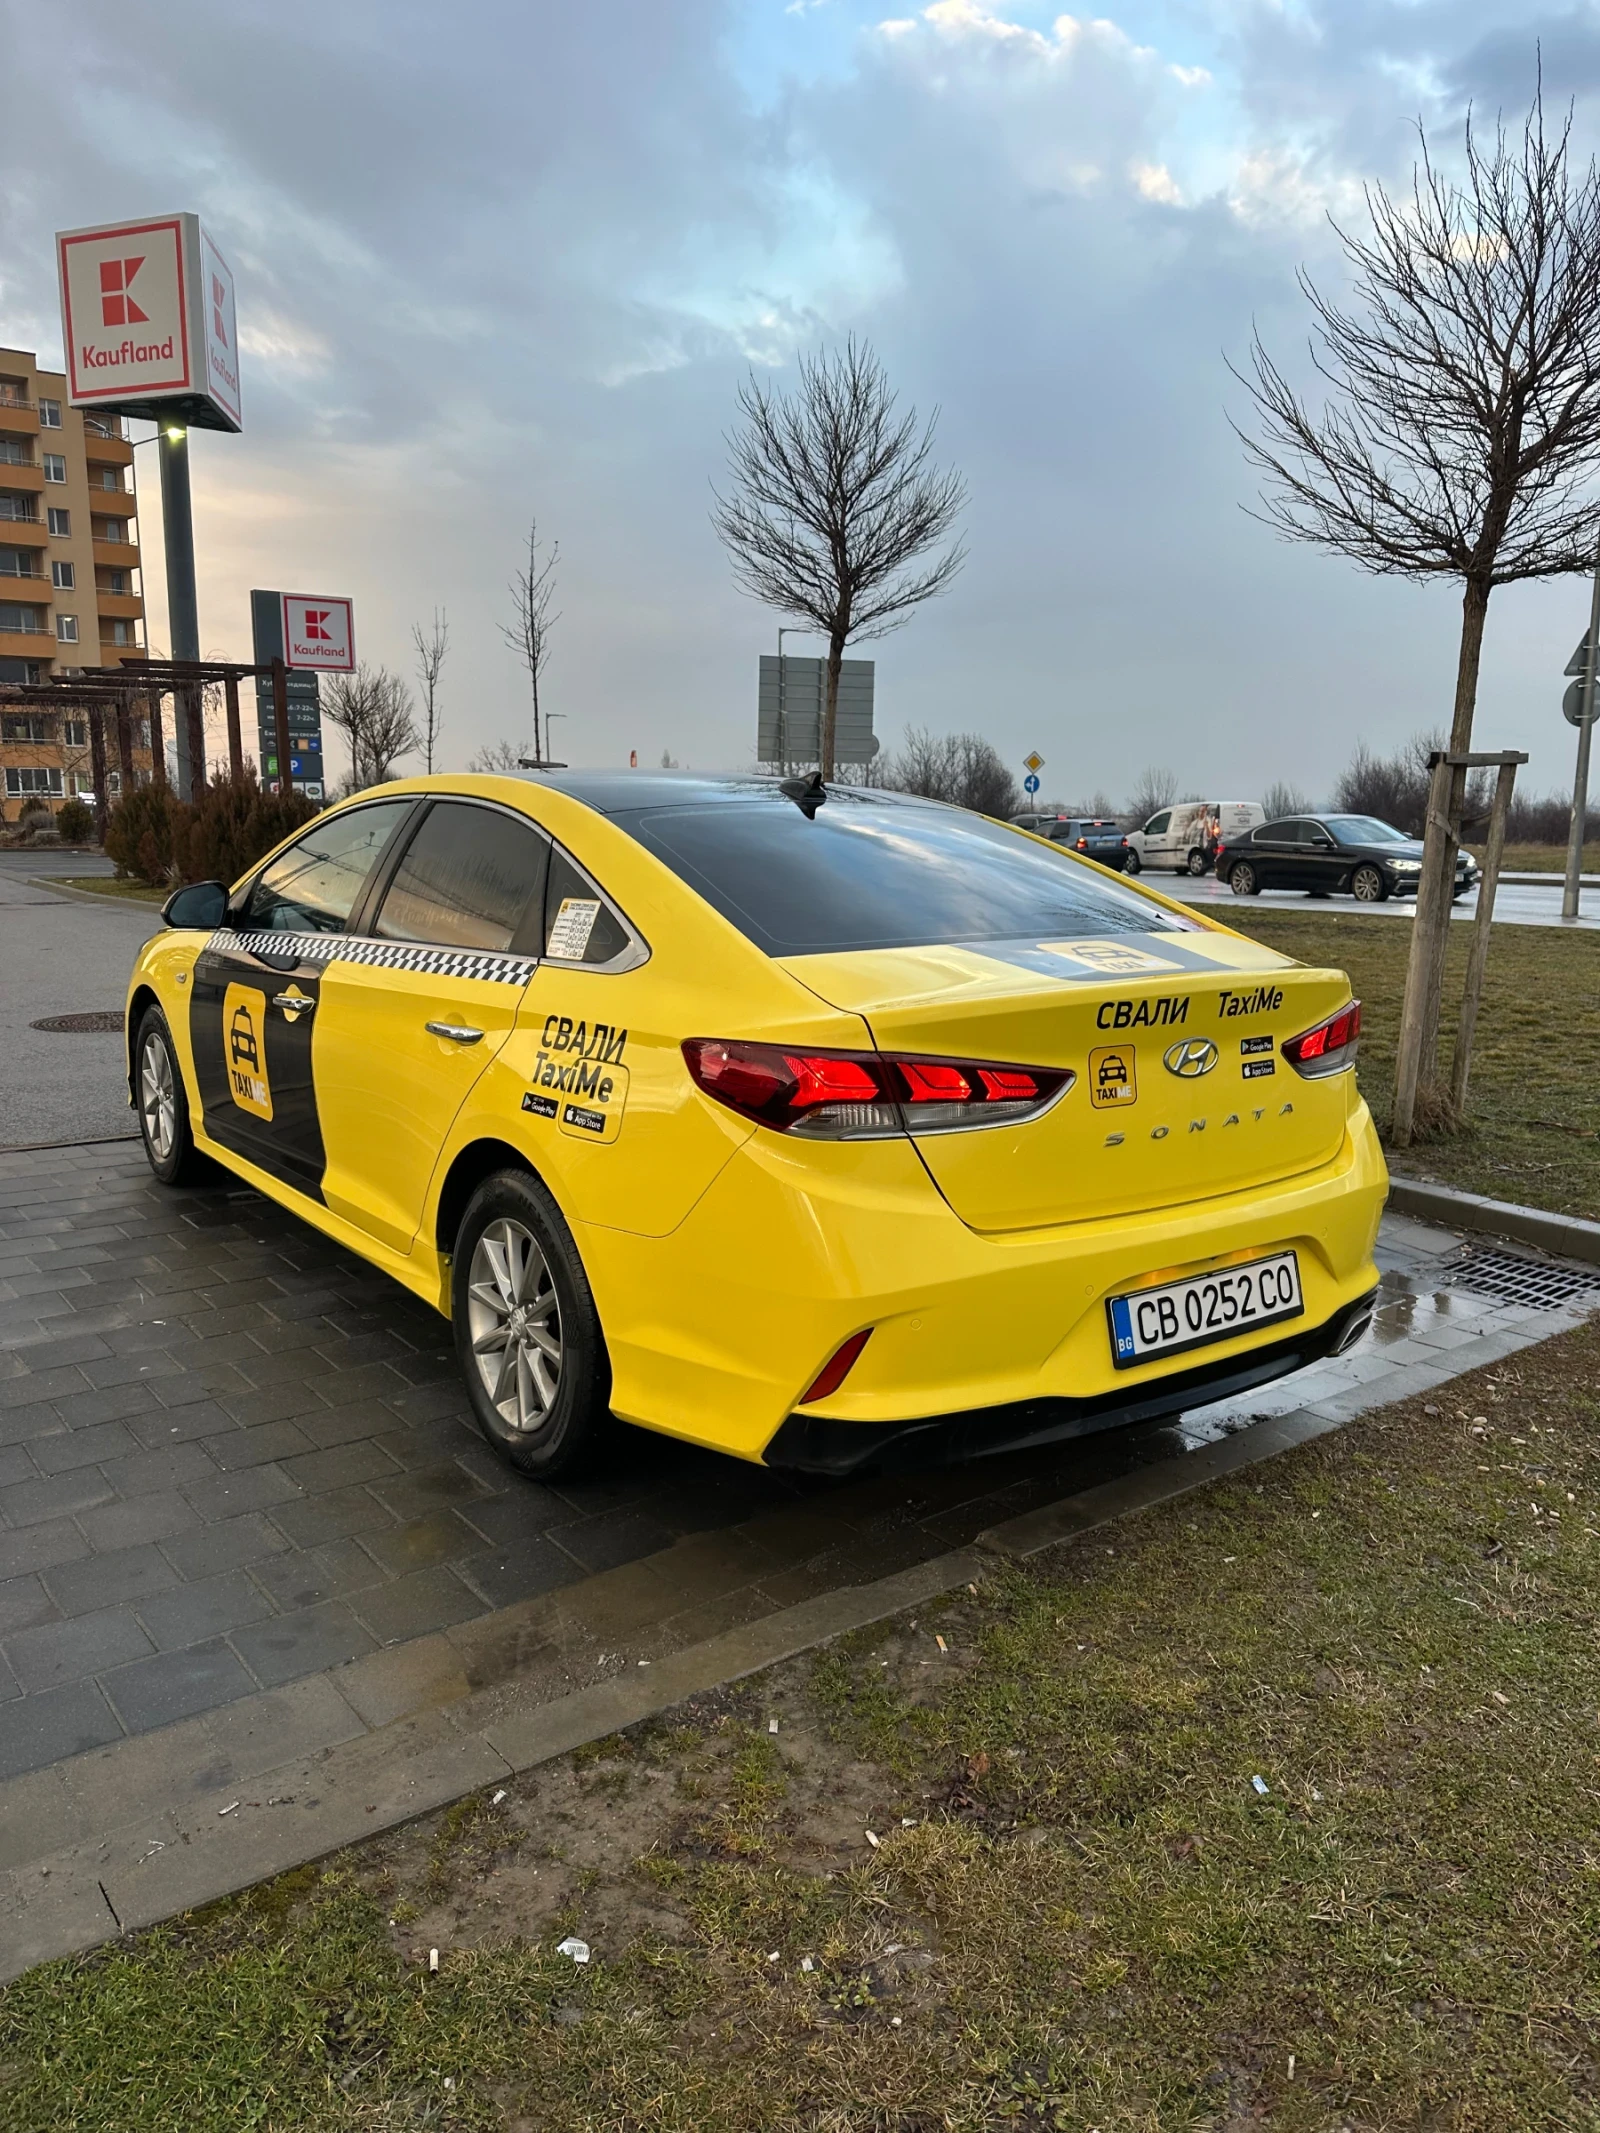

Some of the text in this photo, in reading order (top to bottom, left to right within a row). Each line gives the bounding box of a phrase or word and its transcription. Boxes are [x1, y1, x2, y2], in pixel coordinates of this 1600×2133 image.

[83, 336, 173, 369] Kaufland
[210, 344, 237, 394] Kaufland
[294, 643, 345, 657] Kaufland
[1097, 985, 1283, 1029] СВАЛИ TaxiMe
[541, 1014, 628, 1064] СВАЛИ
[1250, 1043, 1264, 1052] Google
[1264, 1041, 1273, 1050] Play
[532, 1051, 613, 1103] TaxiMe
[1251, 1065, 1273, 1077] App Store
[231, 1069, 268, 1107] TAXIME
[1096, 1085, 1132, 1101] TAXIME
[531, 1101, 556, 1117] Google Play
[574, 1115, 601, 1130] App Store
[1103, 1102, 1294, 1147] SONATA
[1137, 1295, 1179, 1345] CB
[1185, 1274, 1256, 1332] 0252
[1118, 1336, 1133, 1353] BG
